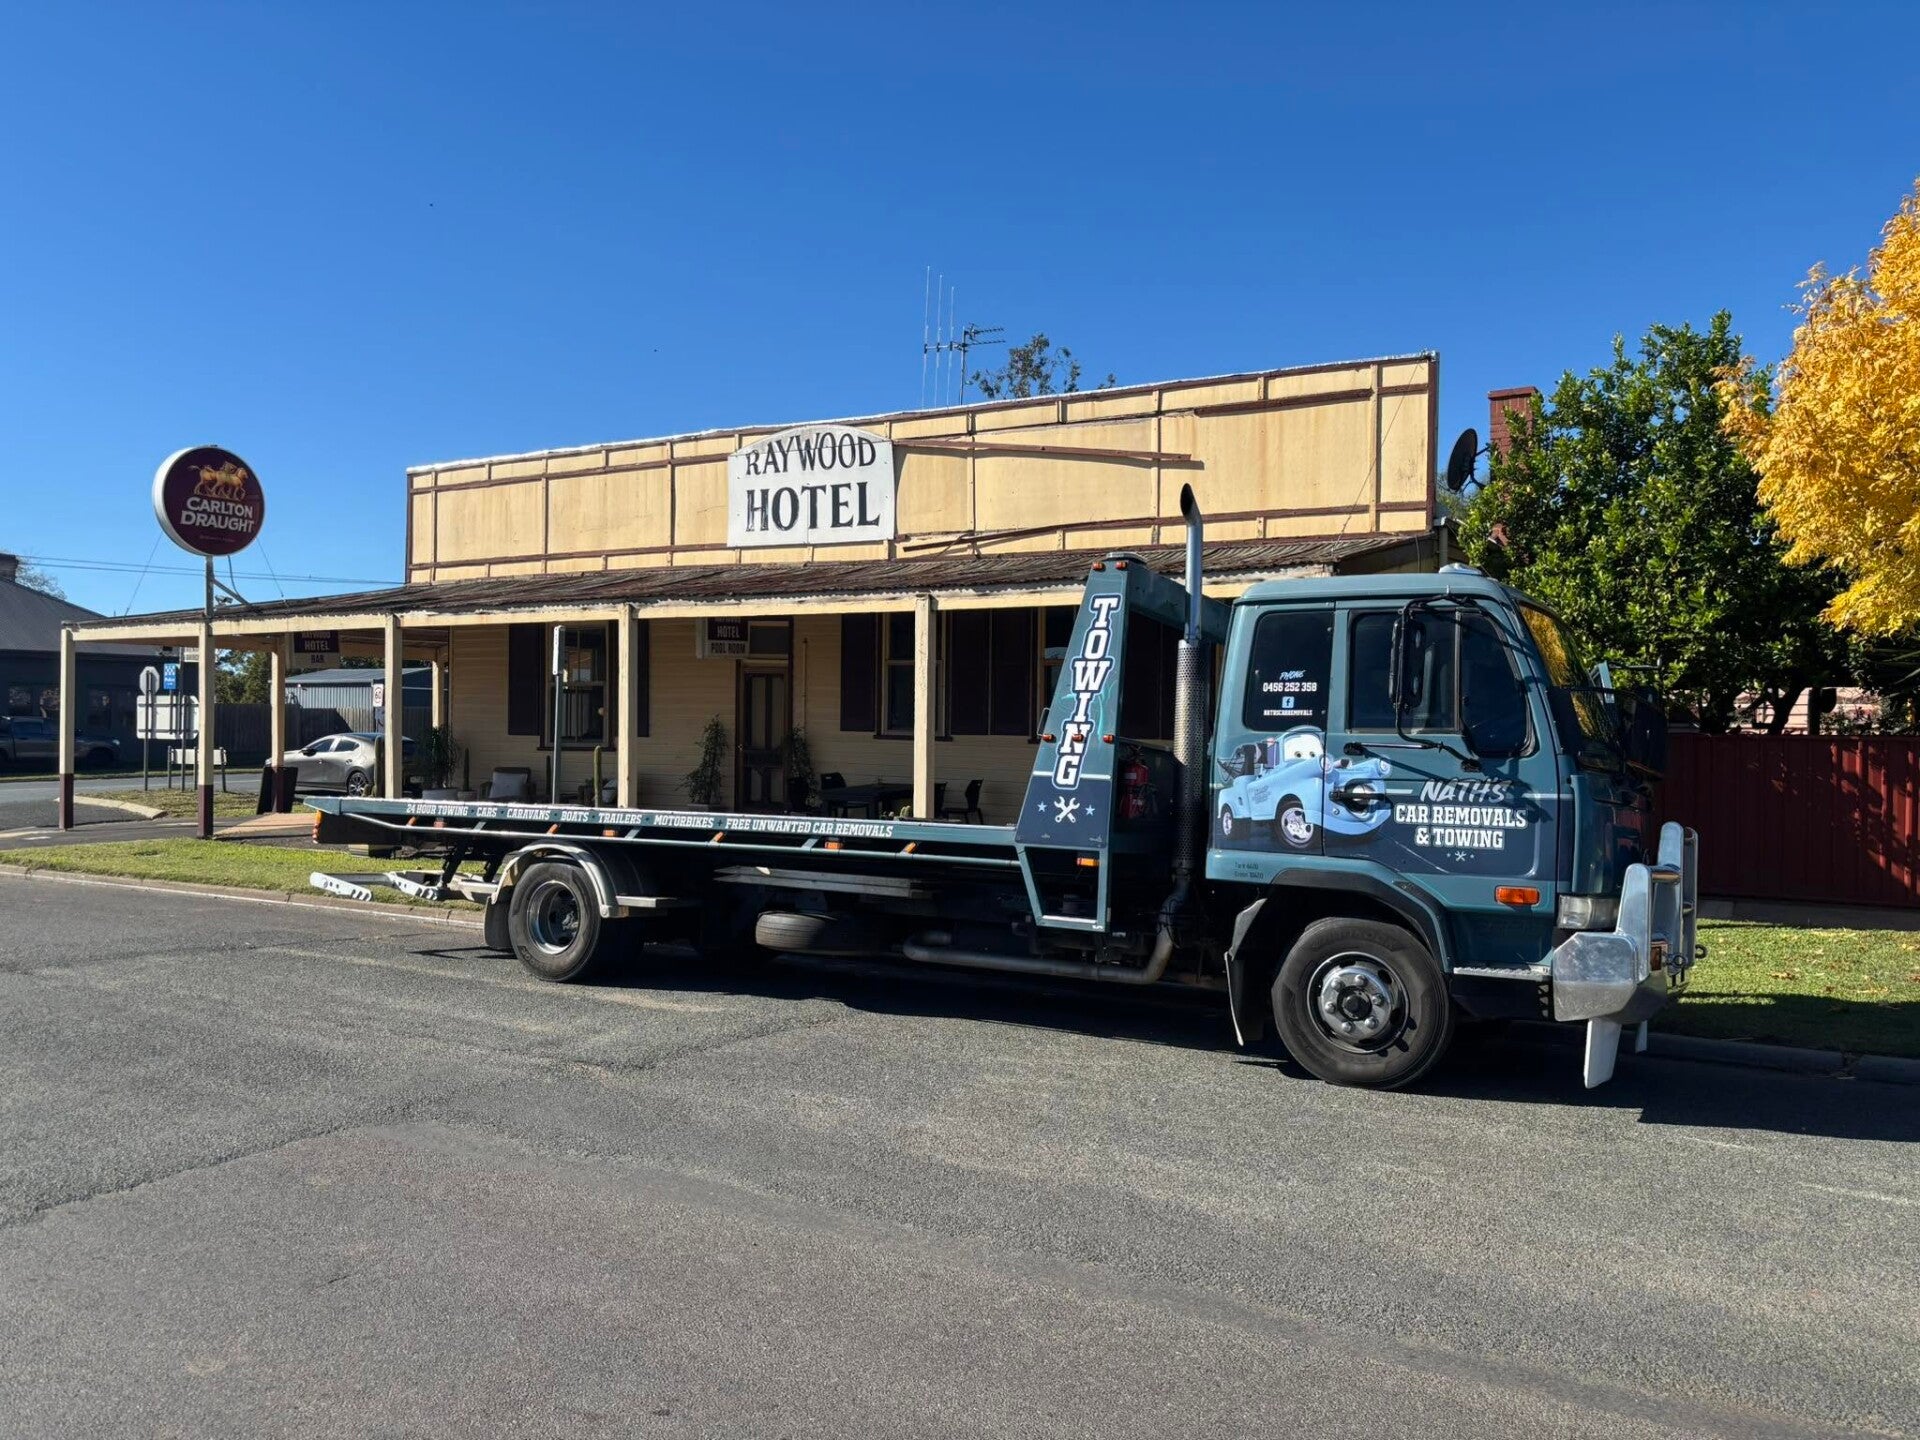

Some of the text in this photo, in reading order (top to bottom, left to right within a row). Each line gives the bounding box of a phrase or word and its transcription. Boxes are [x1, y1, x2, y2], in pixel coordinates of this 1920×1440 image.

[746, 432, 877, 475] RAYWOOD
[186, 496, 254, 518] CARLTON
[746, 481, 881, 532] HOTEL
[180, 510, 255, 533] DRAUGHT
[717, 625, 740, 639] HOTEL
[304, 640, 330, 651] HOTEL
[311, 654, 326, 664] BAR
[1055, 597, 1119, 787] TOWING
[1262, 682, 1318, 692] 0456 252 358
[406, 803, 894, 838] 24 HOUR TOWING CARS CARAVANS BOATS TRAILERS MOTORBIKES FREE UNWANTED CAR REMOVALS
[1395, 804, 1528, 828] CAR REMOVALS
[1415, 827, 1504, 848] & TOWING
